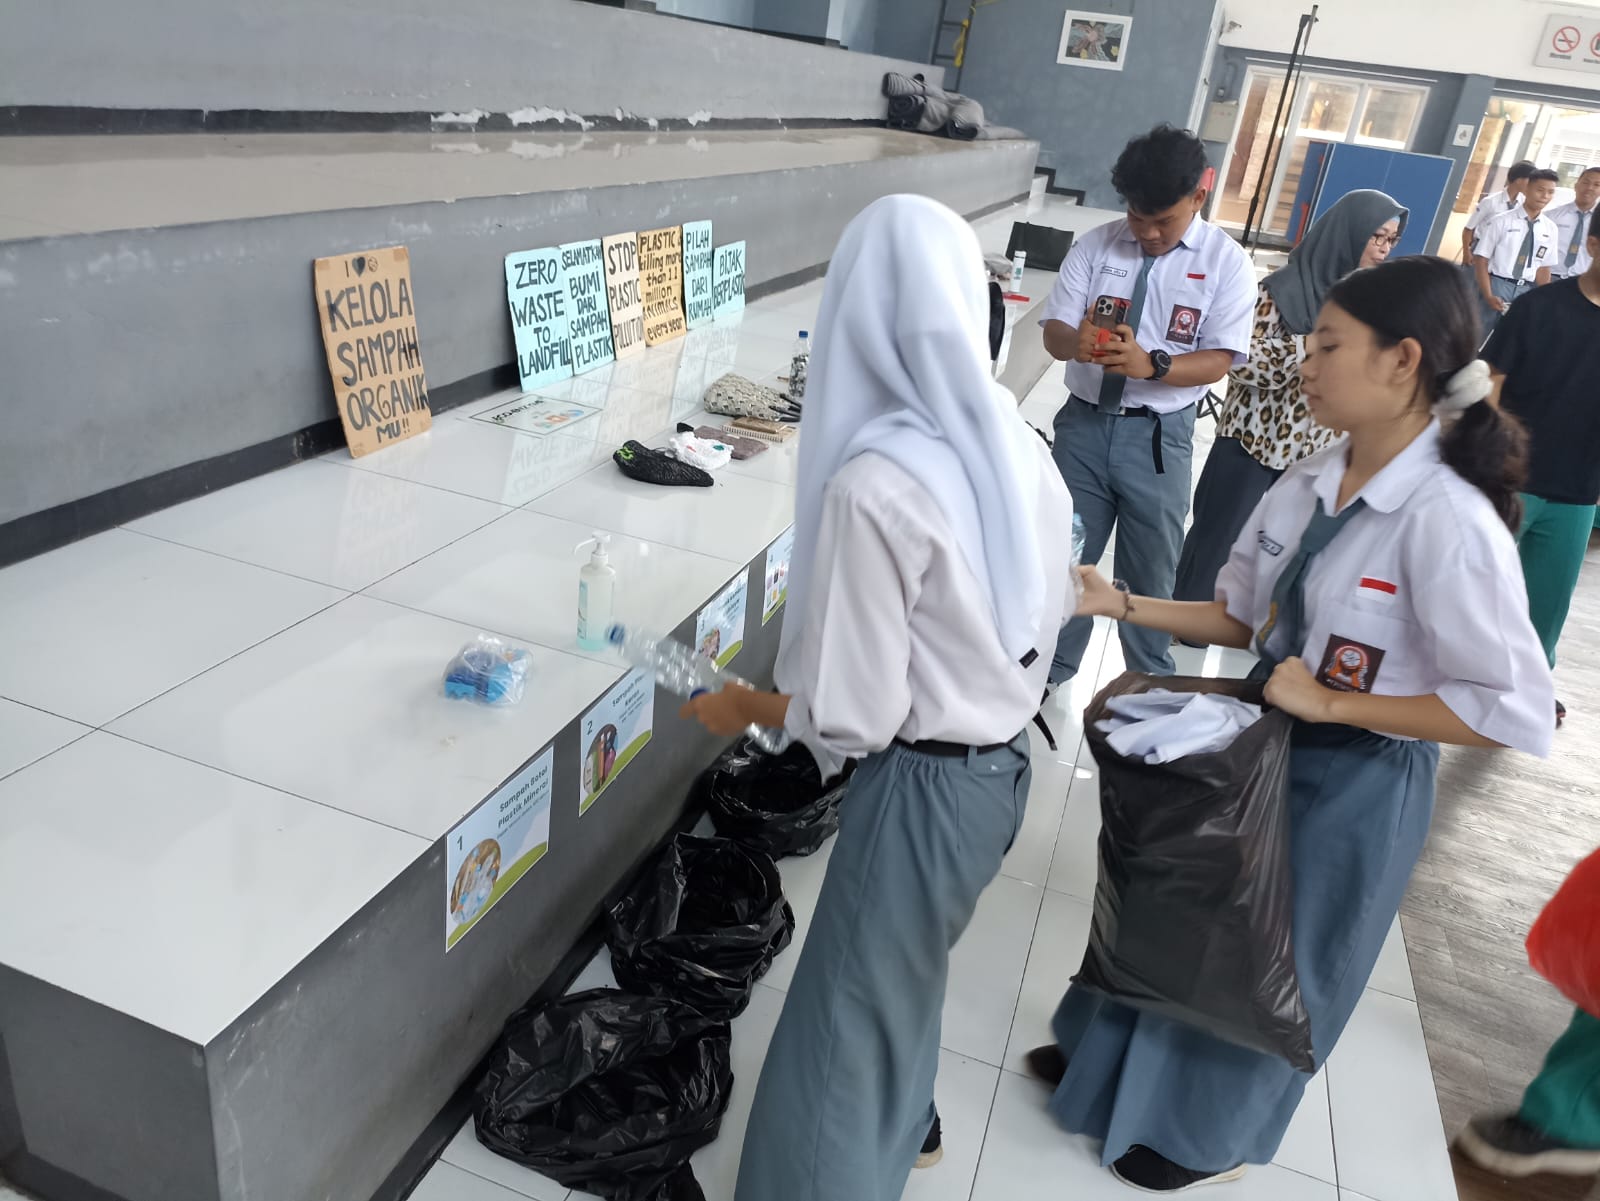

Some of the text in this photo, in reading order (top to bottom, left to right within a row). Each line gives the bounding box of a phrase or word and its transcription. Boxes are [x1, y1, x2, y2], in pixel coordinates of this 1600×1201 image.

[639, 230, 676, 254] PLASTIC
[685, 229, 709, 252] PILAH
[344, 260, 350, 278] I
[607, 240, 637, 275] STOP
[638, 252, 664, 273] killing
[684, 250, 712, 274] SAMPAH
[514, 258, 558, 289] ZERO
[569, 265, 601, 300] BUMI
[646, 271, 667, 287] than
[608, 277, 642, 313] PLASTIC
[645, 285, 673, 303] million
[691, 276, 708, 298] DARI
[325, 278, 413, 333] KELOLA
[511, 290, 565, 328] WASTE
[576, 294, 598, 316] DARI
[688, 297, 713, 323] RUMAH
[533, 326, 550, 348] TO
[570, 310, 609, 340] SAMPAH
[646, 317, 684, 341] every year
[336, 326, 422, 388] SAMPAH
[574, 335, 614, 369] PLASTIK
[346, 373, 430, 432] ORGANIK
[587, 720, 593, 736] 2
[499, 764, 548, 813] Sampah Botol
[498, 801, 523, 829] Plastik
[523, 777, 549, 807] Mineral
[457, 835, 463, 851] 1
